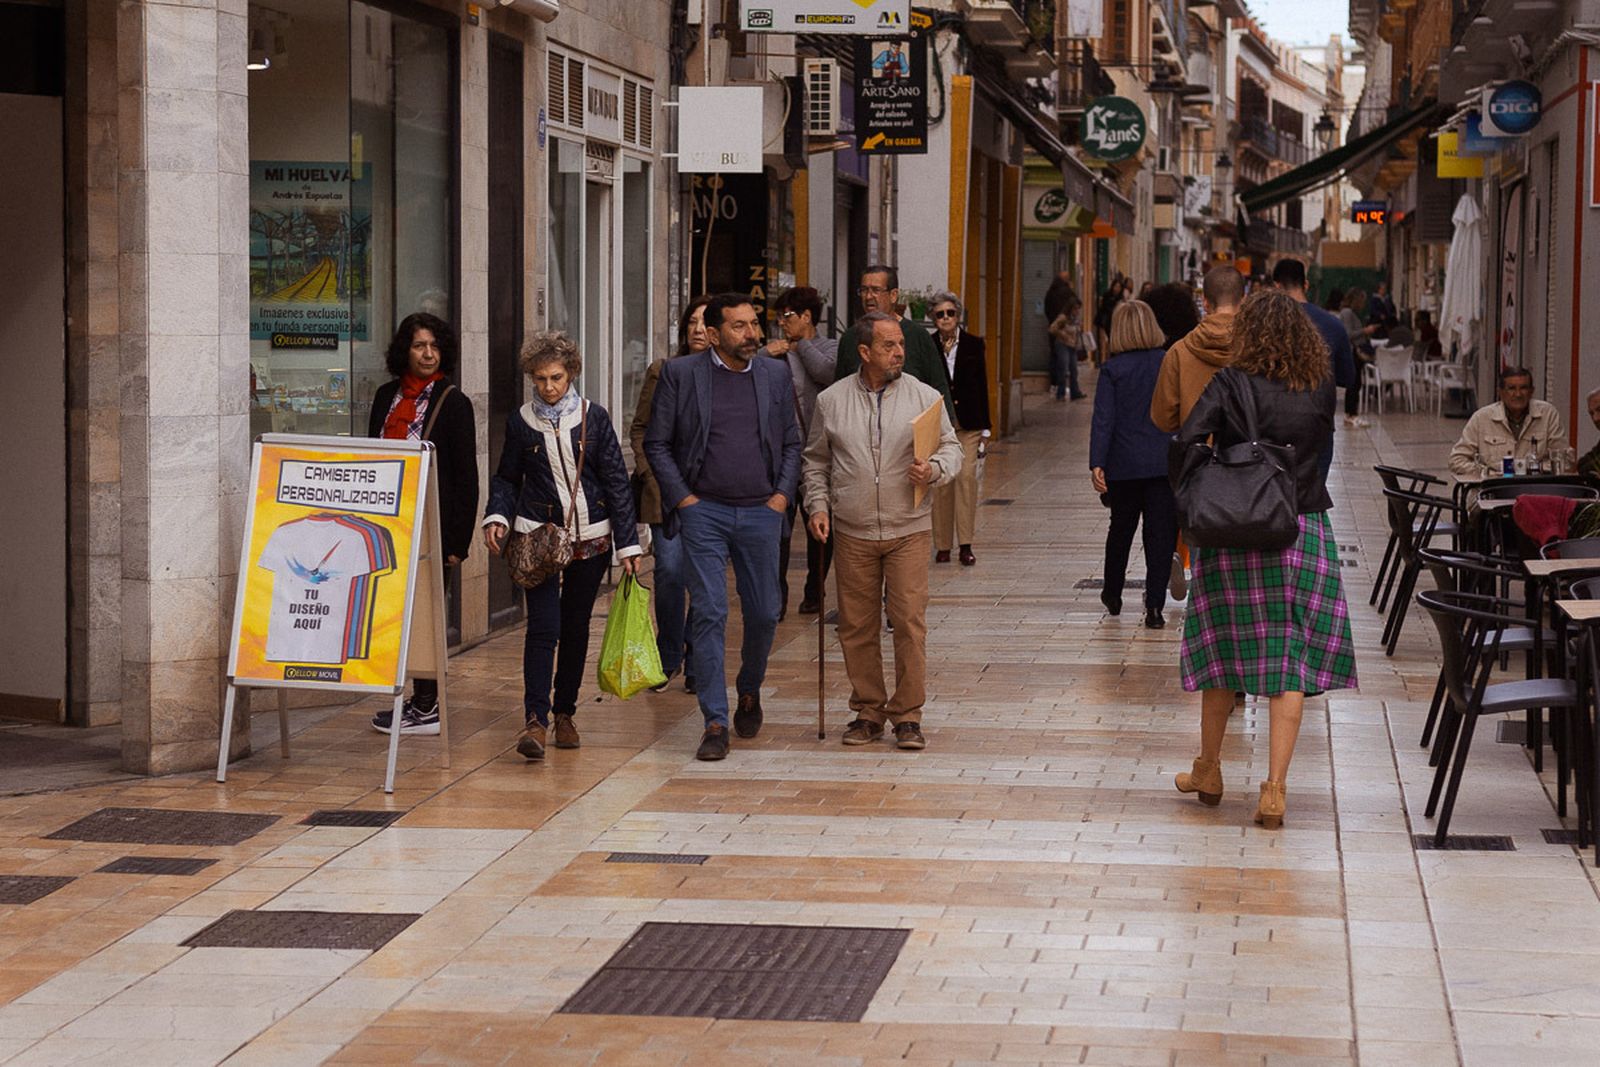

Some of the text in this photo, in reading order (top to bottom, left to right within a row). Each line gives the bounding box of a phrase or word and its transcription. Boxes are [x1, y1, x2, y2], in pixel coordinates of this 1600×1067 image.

[862, 79, 874, 87] EL
[1490, 101, 1539, 114] DIGI
[885, 138, 894, 146] EN
[264, 168, 356, 183] MI HUELVA
[305, 191, 343, 201] Espuelas
[1356, 211, 1368, 223] 14
[274, 321, 300, 334] funda
[304, 466, 377, 483] CAMISETAS
[281, 485, 396, 505] PERSONALIZADAS
[304, 589, 319, 601] TU
[289, 602, 330, 616] DISEÑO
[293, 617, 322, 630] AQUÍ
